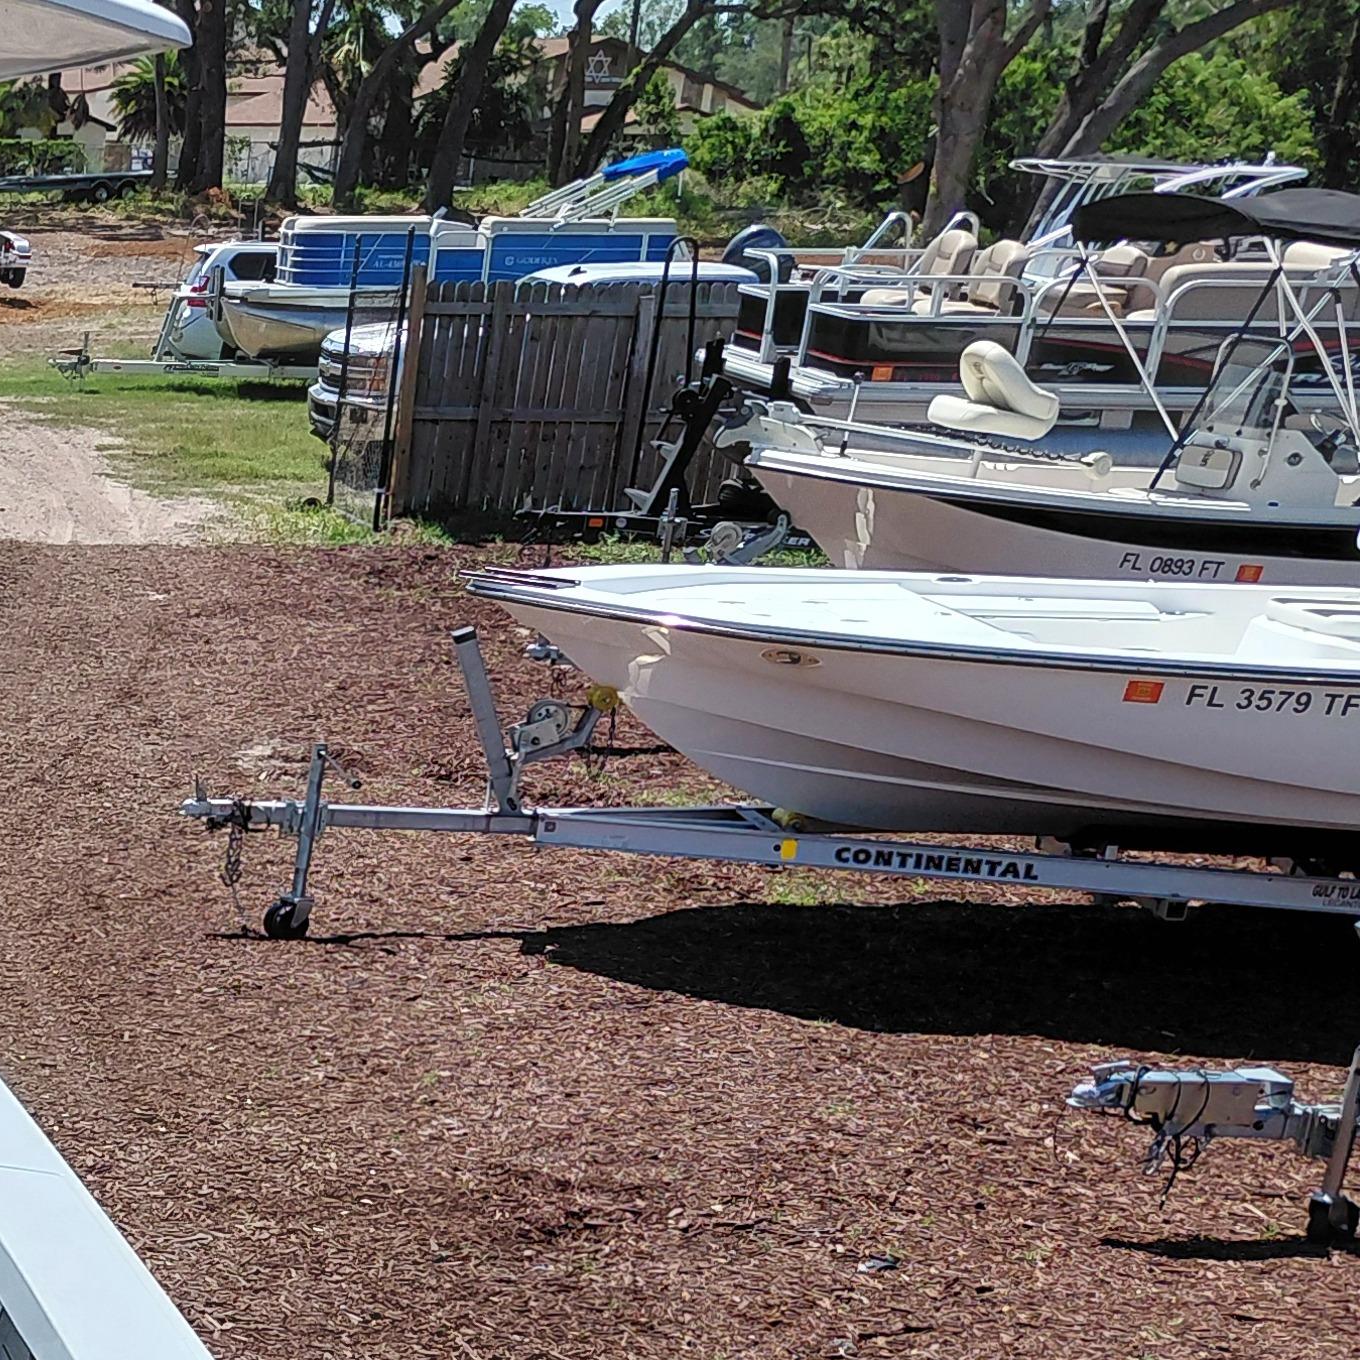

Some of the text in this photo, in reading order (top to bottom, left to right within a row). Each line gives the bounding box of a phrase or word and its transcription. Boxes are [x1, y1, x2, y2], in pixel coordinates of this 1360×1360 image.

[1119, 552, 1142, 571] FL
[1149, 556, 1195, 576] 0893
[1198, 560, 1225, 578] FT
[1185, 685, 1224, 708] FL
[1236, 688, 1312, 714] 3579
[1324, 693, 1360, 716] TF
[834, 847, 1039, 880] CONTINENTAL
